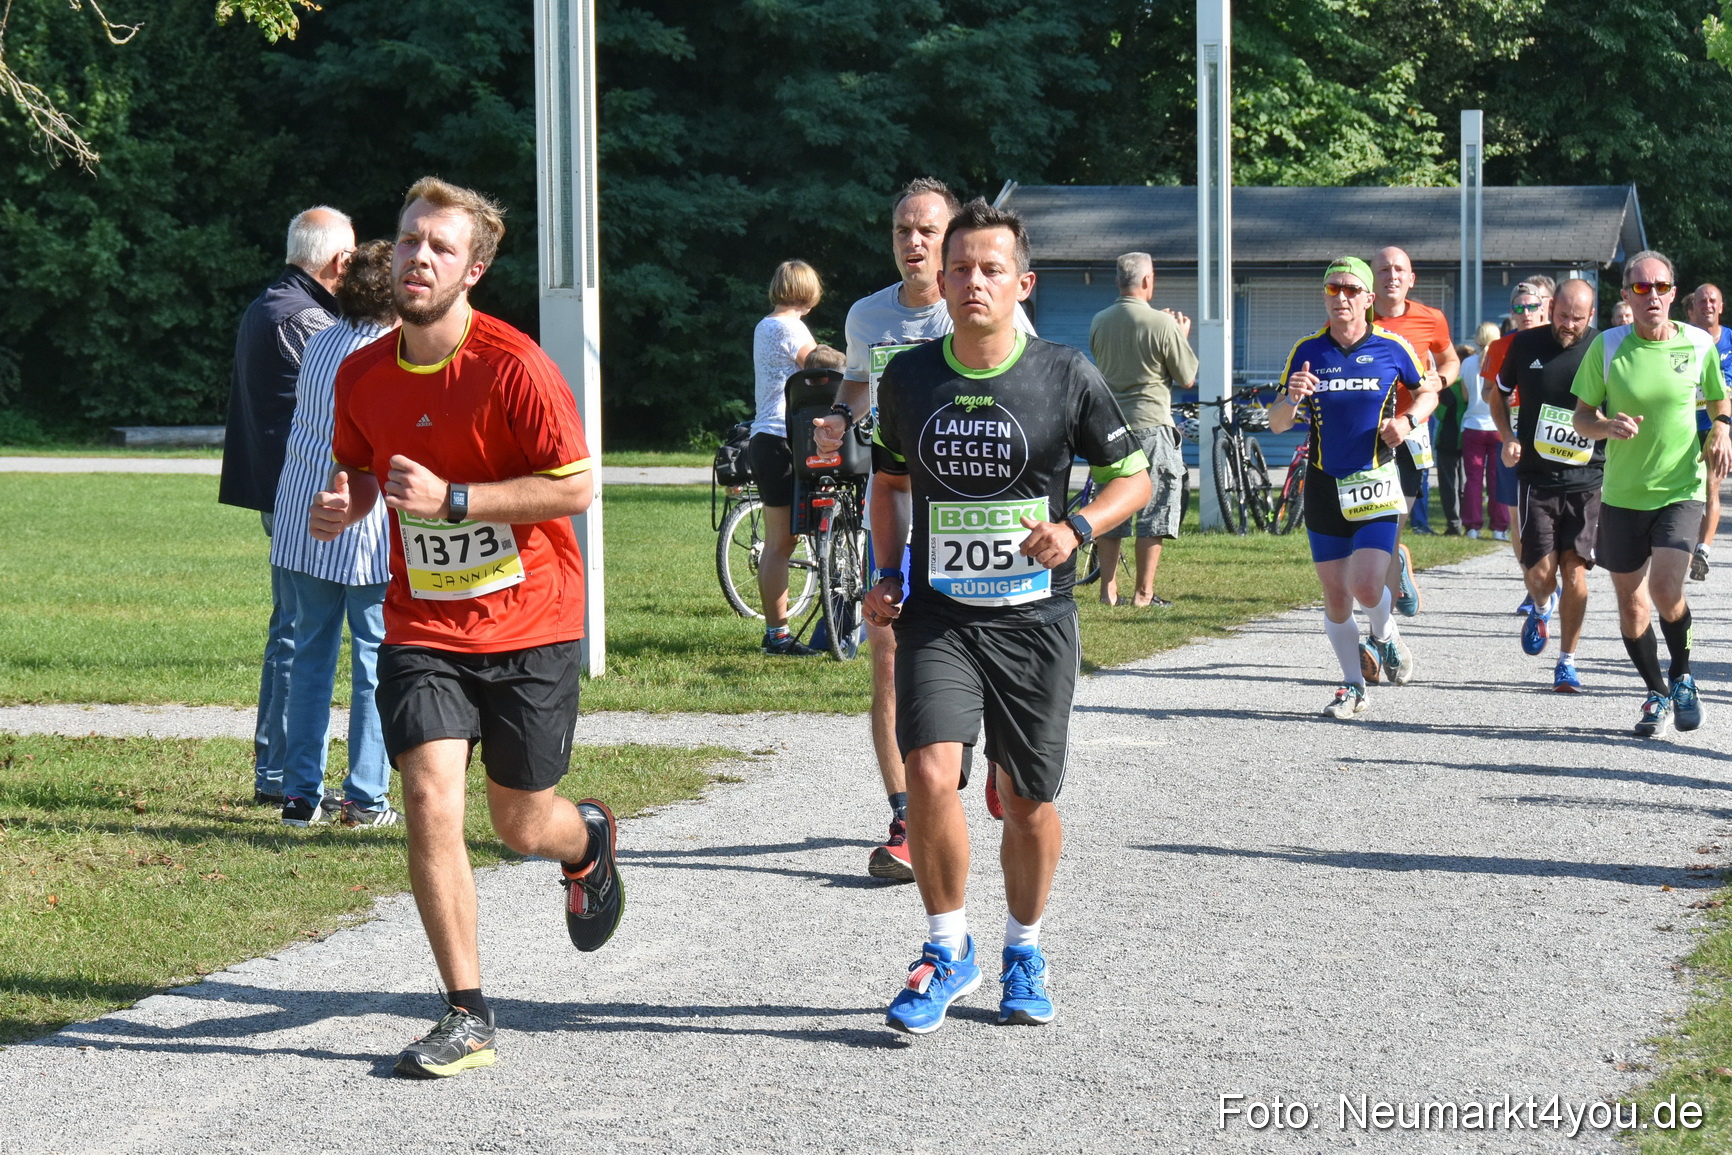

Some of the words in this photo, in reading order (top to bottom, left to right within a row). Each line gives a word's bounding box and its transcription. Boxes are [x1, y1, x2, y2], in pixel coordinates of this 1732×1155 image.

[1315, 367, 1342, 375] TEAM
[1315, 378, 1380, 393] BOCK
[954, 395, 995, 413] vegan
[935, 419, 1011, 438] LAUFEN
[1545, 425, 1589, 448] 1048
[933, 441, 1011, 460] GEGEN
[1550, 447, 1574, 458] SVEN
[936, 461, 1011, 478] LEIDEN
[1348, 480, 1391, 503] 1007
[939, 504, 1038, 530] BOCK
[1348, 504, 1374, 515] FRANZ
[414, 526, 499, 566] 1373
[431, 563, 505, 588] JANNIK
[950, 578, 1033, 595] RÜDIGER
